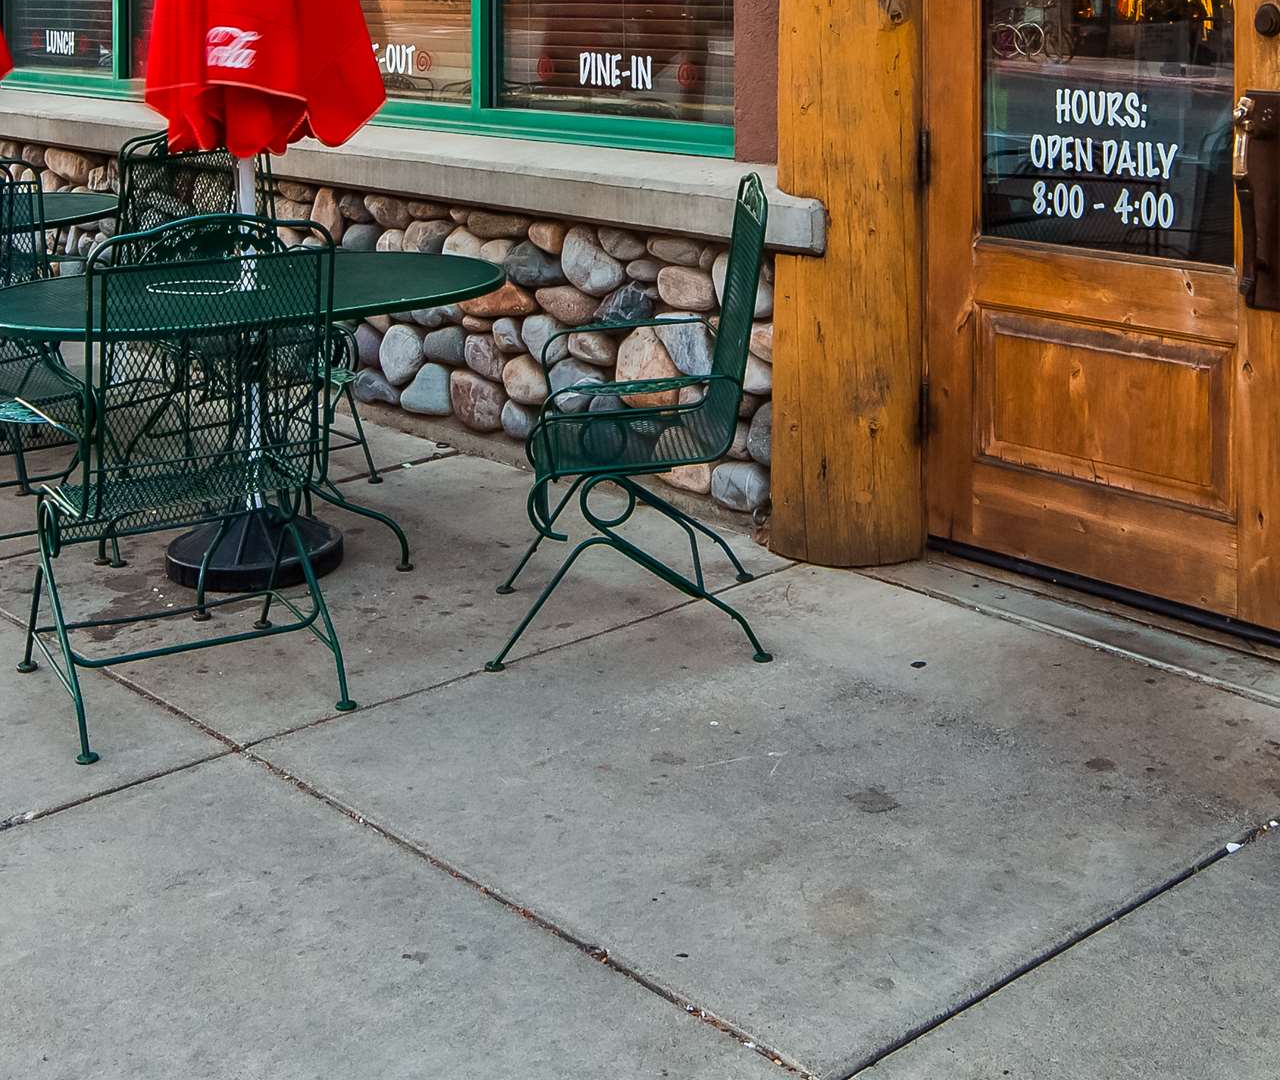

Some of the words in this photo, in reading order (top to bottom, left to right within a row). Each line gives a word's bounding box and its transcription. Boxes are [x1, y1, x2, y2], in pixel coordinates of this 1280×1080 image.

[46, 29, 75, 55] LUNCH
[580, 52, 652, 90] DINE-IN
[1056, 88, 1147, 128] HOURS:
[1030, 134, 1093, 172] OPEN
[1102, 139, 1178, 179] DAILY
[1032, 180, 1084, 219] 8:00
[1093, 202, 1105, 210] -
[1114, 188, 1174, 229] 4:00
